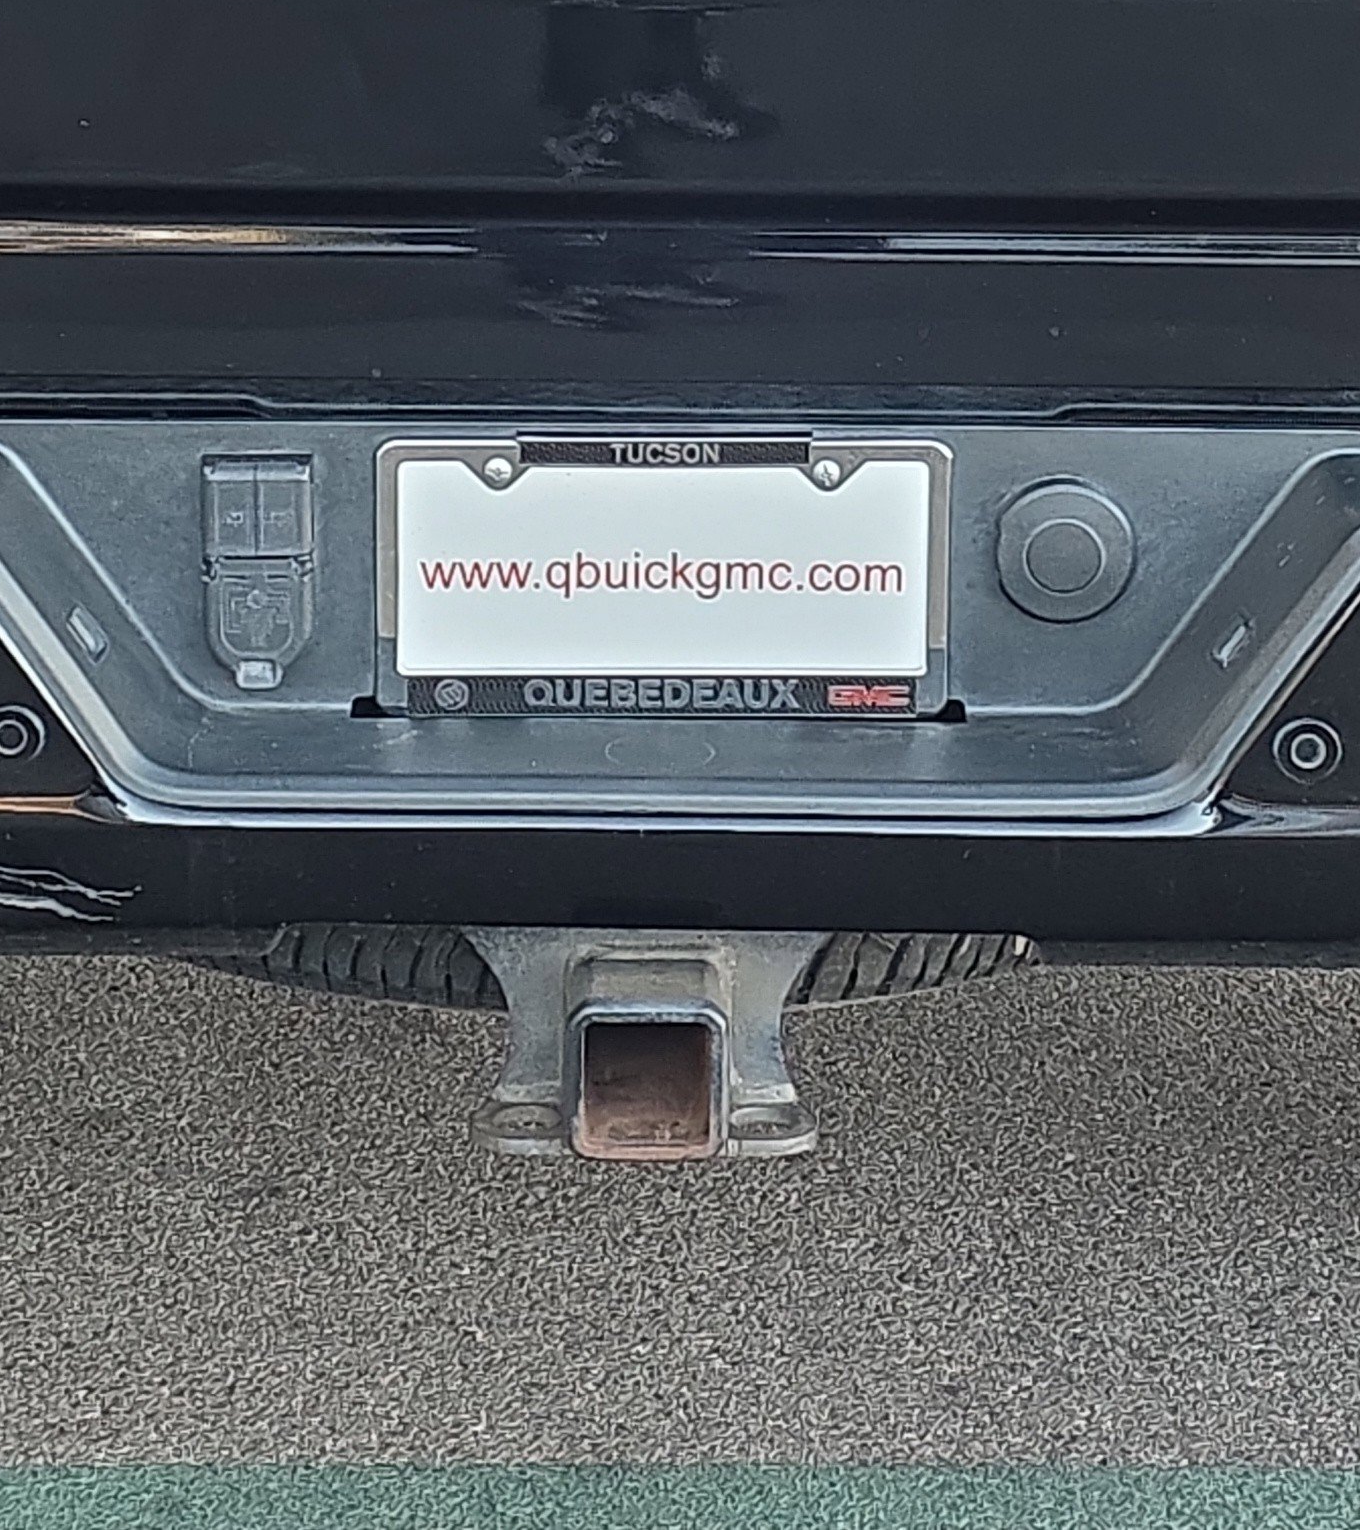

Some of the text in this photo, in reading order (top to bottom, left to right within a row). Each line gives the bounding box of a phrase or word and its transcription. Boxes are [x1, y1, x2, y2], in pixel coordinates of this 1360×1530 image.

[609, 443, 721, 465] TUCSON
[420, 552, 904, 600] www.qbuickgmc.com
[524, 677, 911, 710] QUEBEDEAUX GMC
